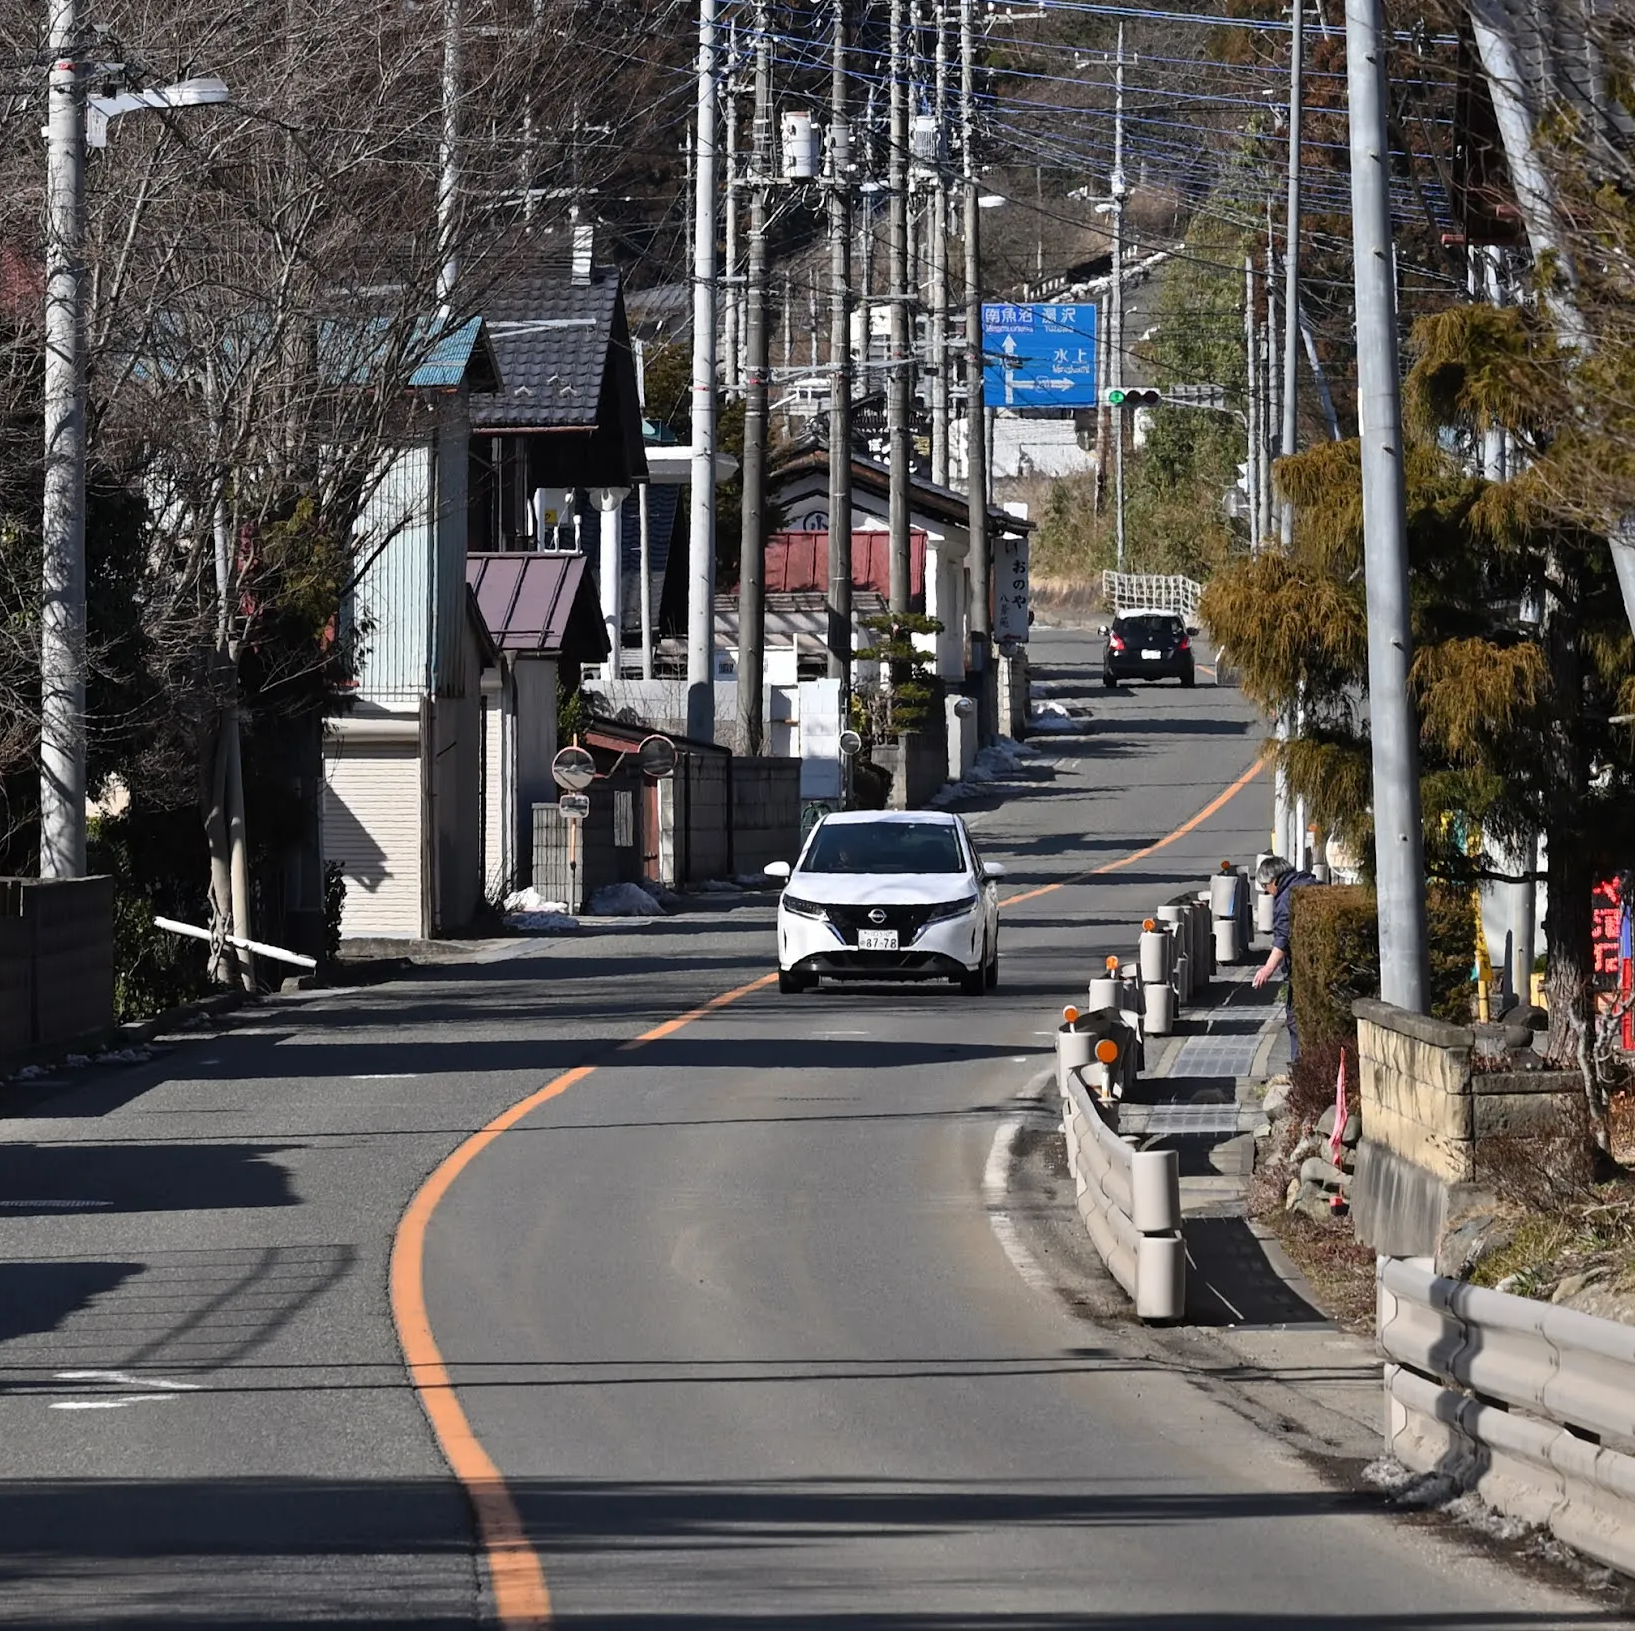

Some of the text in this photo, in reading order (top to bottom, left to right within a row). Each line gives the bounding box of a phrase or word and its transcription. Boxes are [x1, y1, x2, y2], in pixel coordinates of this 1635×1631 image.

[985, 307, 1076, 324] 南魚沼 湯沢
[1053, 348, 1087, 363] 水上
[1012, 559, 1026, 610] おのや
